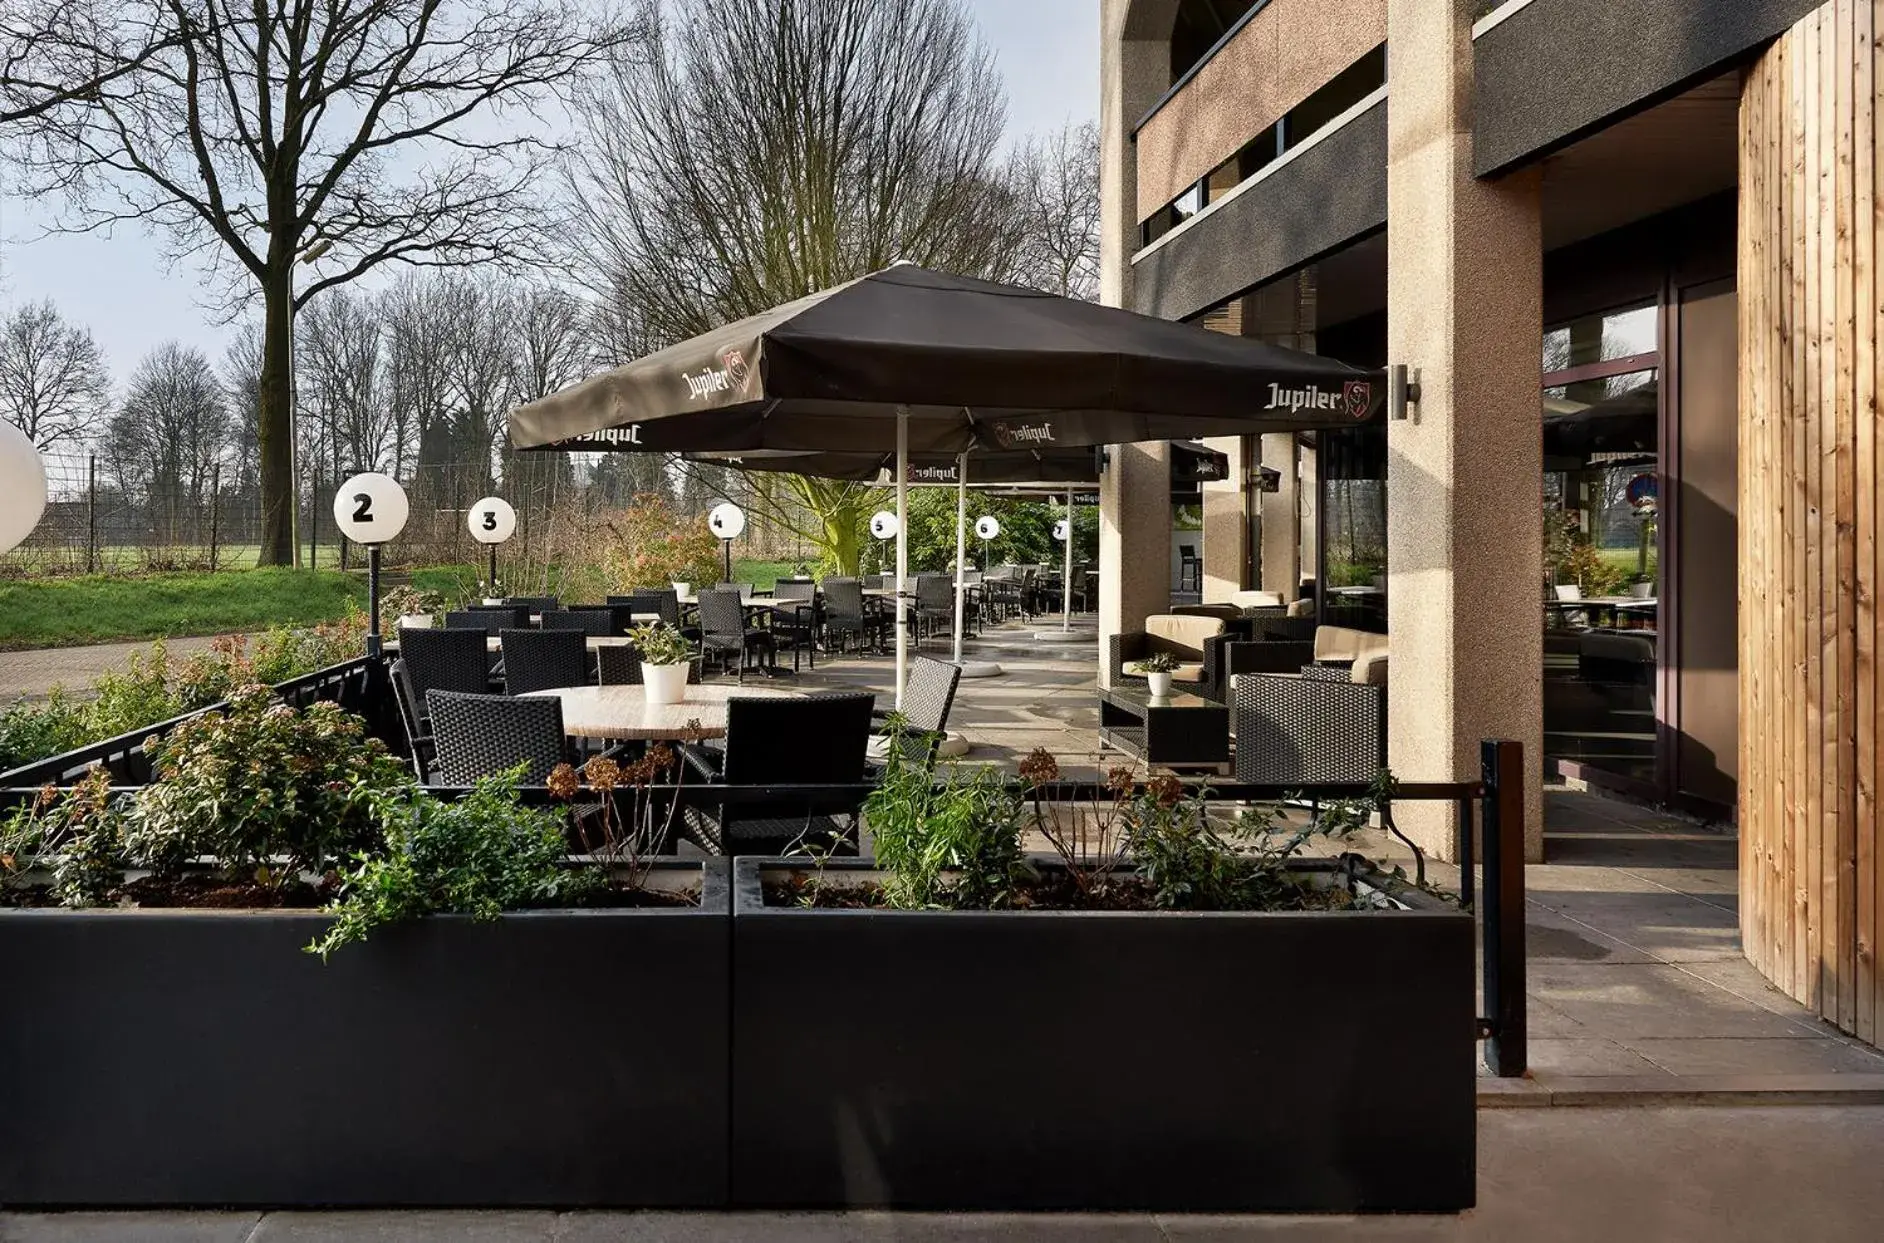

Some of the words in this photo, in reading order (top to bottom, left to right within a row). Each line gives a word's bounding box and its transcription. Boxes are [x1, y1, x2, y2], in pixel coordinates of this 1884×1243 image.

[682, 367, 729, 400] Jupiler
[1263, 382, 1342, 413] Jupiler
[352, 493, 373, 522] 2
[482, 511, 497, 531] 3
[713, 514, 723, 529] 4
[875, 520, 883, 531] 5
[980, 523, 988, 533] 6
